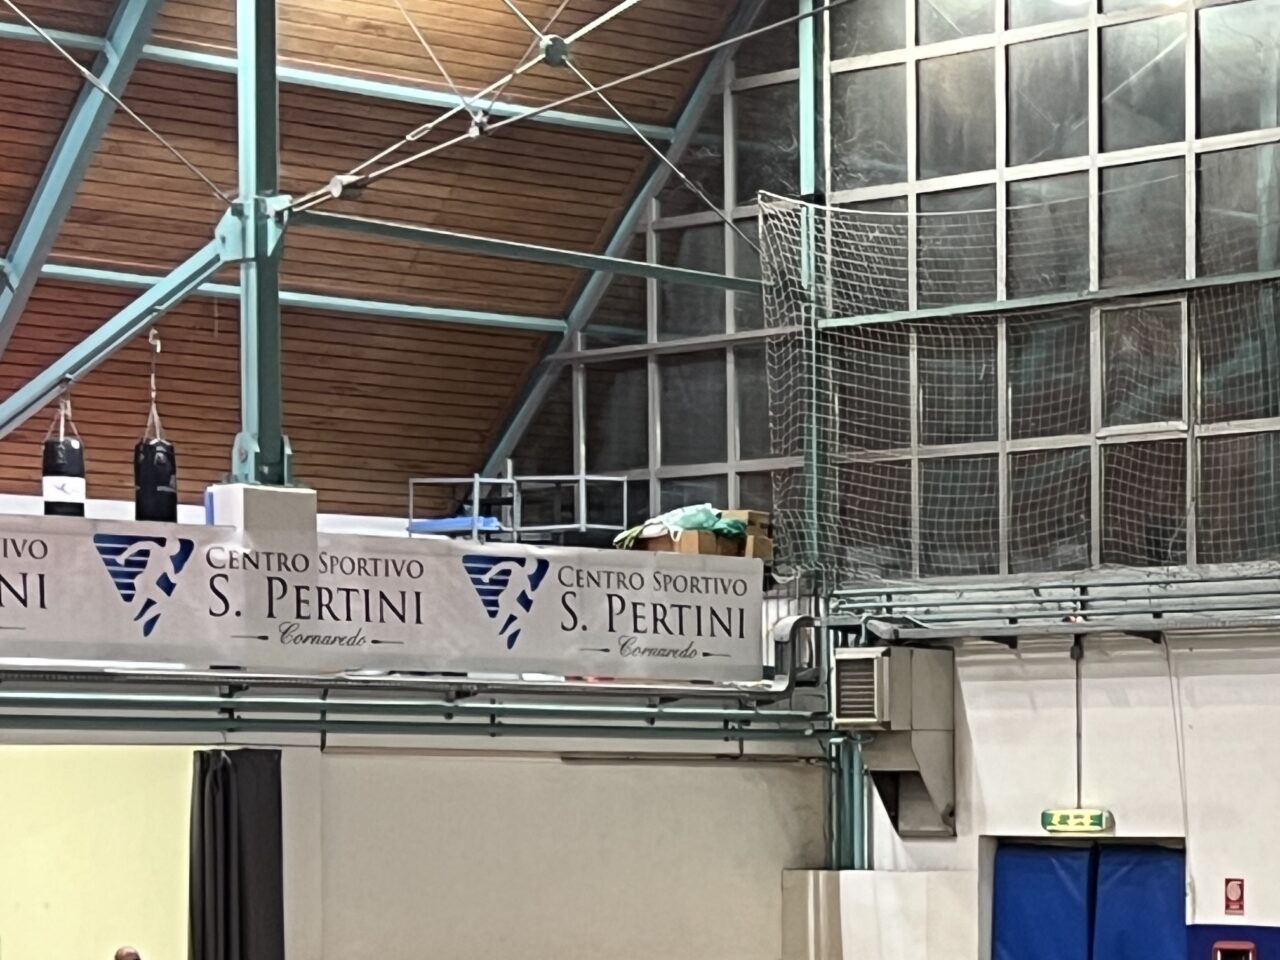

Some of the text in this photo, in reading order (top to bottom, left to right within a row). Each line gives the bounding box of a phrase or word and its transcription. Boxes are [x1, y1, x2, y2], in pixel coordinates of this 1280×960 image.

[0, 538, 48, 560] IVO
[205, 546, 425, 579] CENTRO SPORTIVO
[557, 565, 748, 596] CENTRO SPORTIVO
[208, 573, 424, 625] S. PERTINI
[560, 590, 745, 639] S. PERTINI
[278, 621, 367, 646] Cornaredo
[617, 634, 698, 660] Cornaredo
